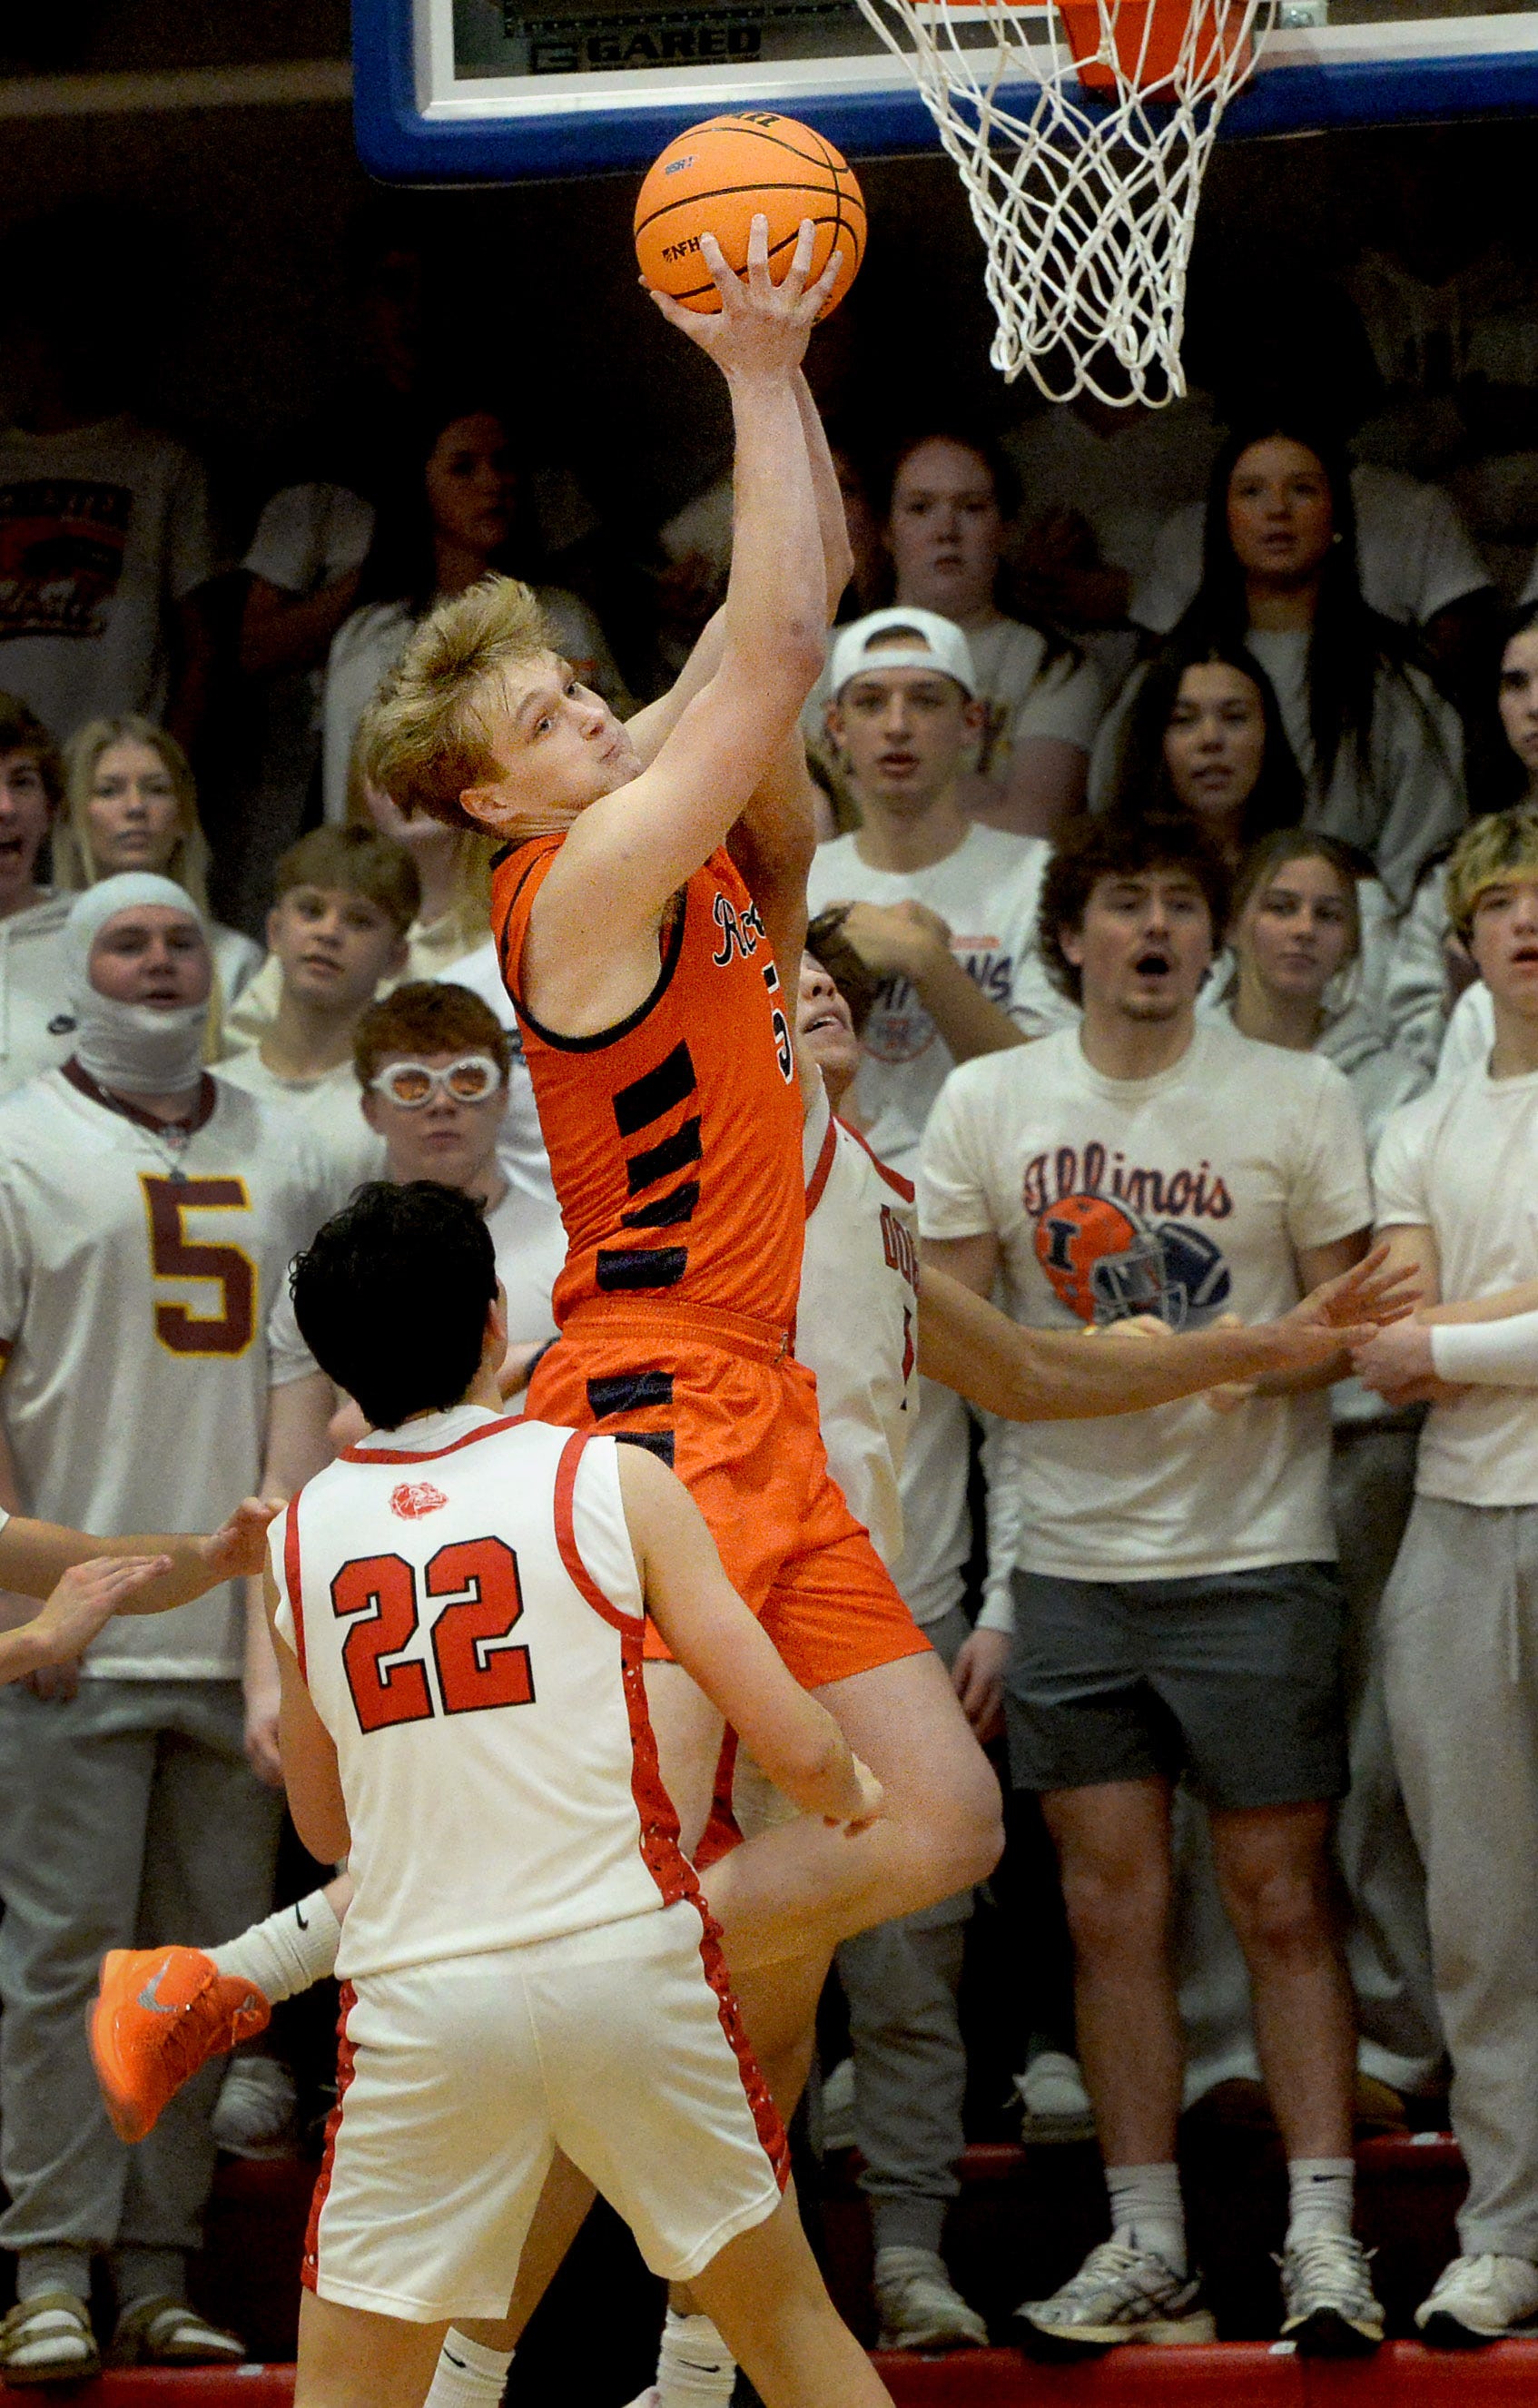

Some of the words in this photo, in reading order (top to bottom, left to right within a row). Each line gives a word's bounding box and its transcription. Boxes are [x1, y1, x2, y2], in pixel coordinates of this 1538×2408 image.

[587, 27, 762, 61] GARED
[1022, 1140, 1234, 1219] Illinois
[139, 1172, 257, 1357] 5
[1044, 1216, 1082, 1272] I
[330, 1534, 537, 1734] 22
